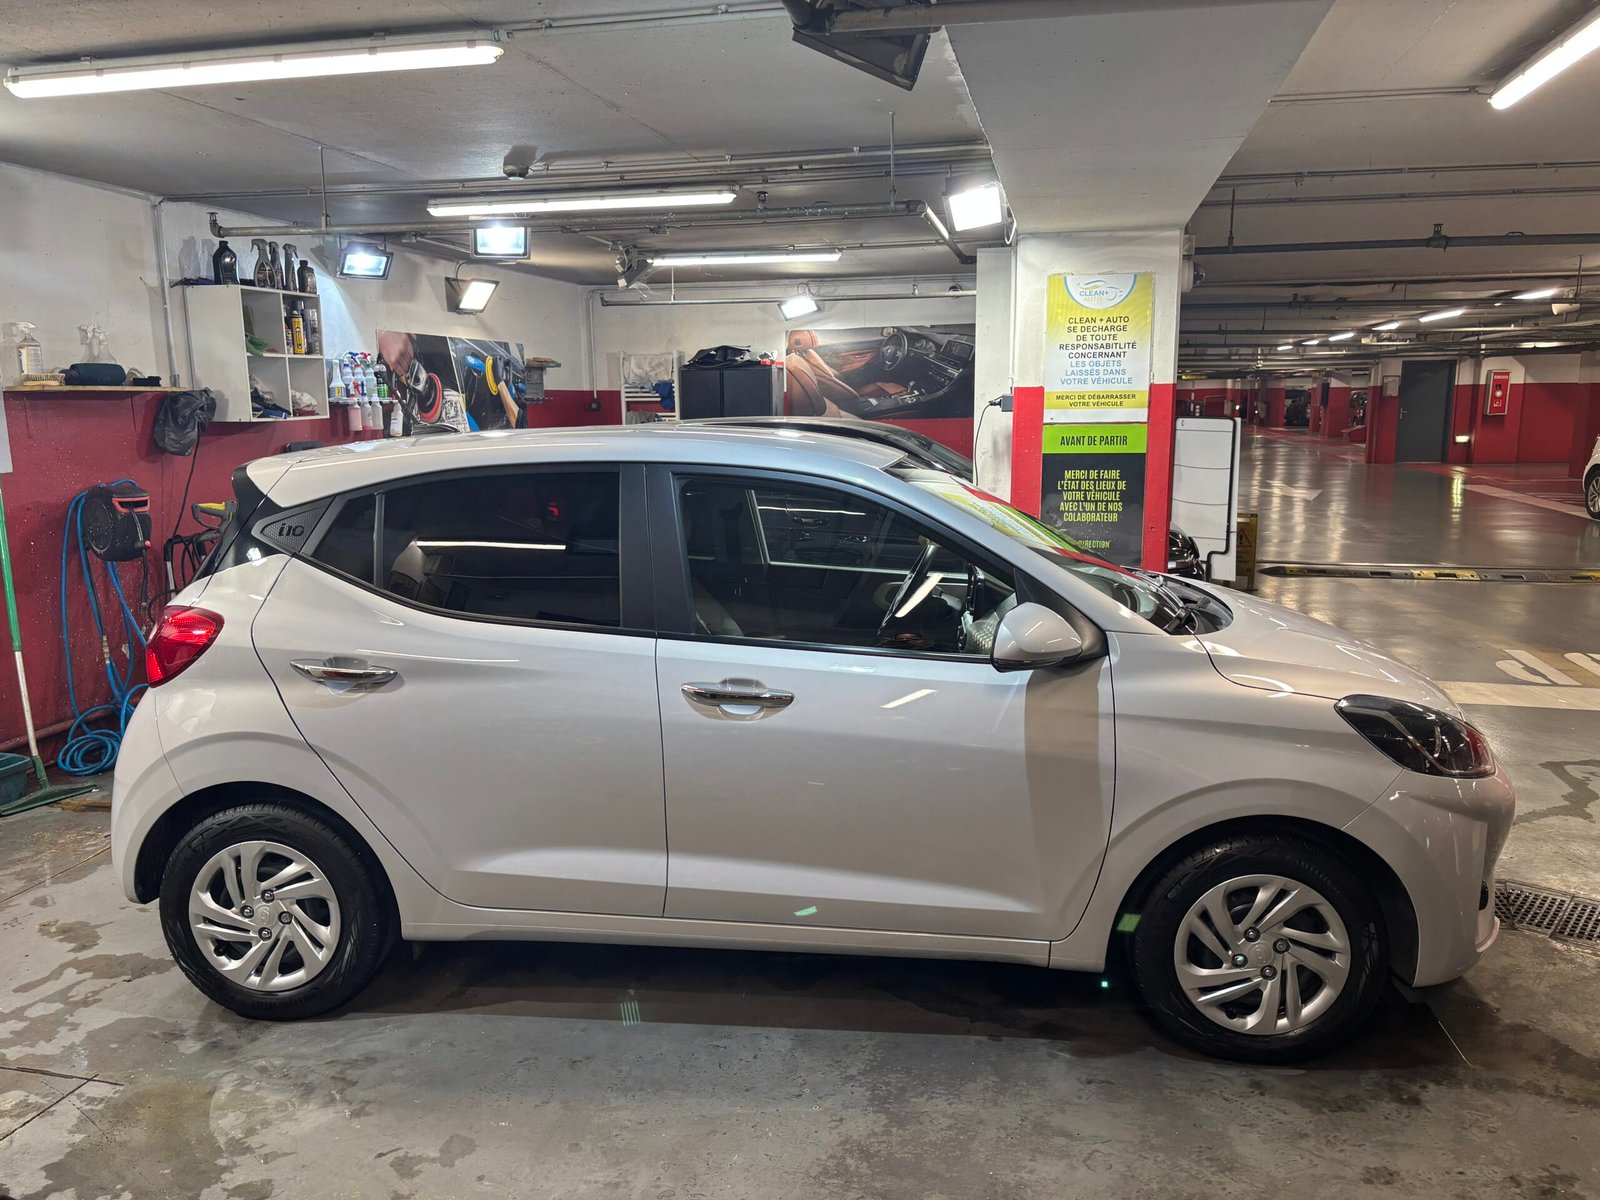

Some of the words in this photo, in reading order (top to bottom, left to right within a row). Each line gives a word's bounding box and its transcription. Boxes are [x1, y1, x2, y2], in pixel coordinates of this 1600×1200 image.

[1059, 341, 1137, 351] RESPONSABITLITÉ
[1068, 351, 1127, 359] CONCERNANT
[1065, 368, 1100, 376] LAISSÉS
[1103, 368, 1127, 376] DANS
[1060, 377, 1088, 385] VOTRE
[1091, 376, 1133, 384] VÉHICULE
[1060, 436, 1085, 446] AVANT
[1088, 436, 1097, 446] DE
[1099, 436, 1128, 446] PARTIR
[1064, 470, 1087, 479] MERCI
[1089, 470, 1099, 479] DE
[1100, 470, 1120, 479] FAIRE
[1058, 479, 1079, 490] L'ÉTAT
[1081, 481, 1094, 490] DES
[1096, 481, 1116, 490] LIEUX
[1118, 481, 1127, 490] DE
[1063, 491, 1084, 500] VOTRE
[1086, 489, 1120, 500] VÉHICULE
[1060, 502, 1078, 511] AVEC
[1079, 502, 1095, 511] L'UN
[1097, 502, 1106, 511] DE
[1107, 502, 1123, 511] NOS
[1063, 512, 1118, 522] COLABORATEUR
[278, 523, 305, 537] i10
